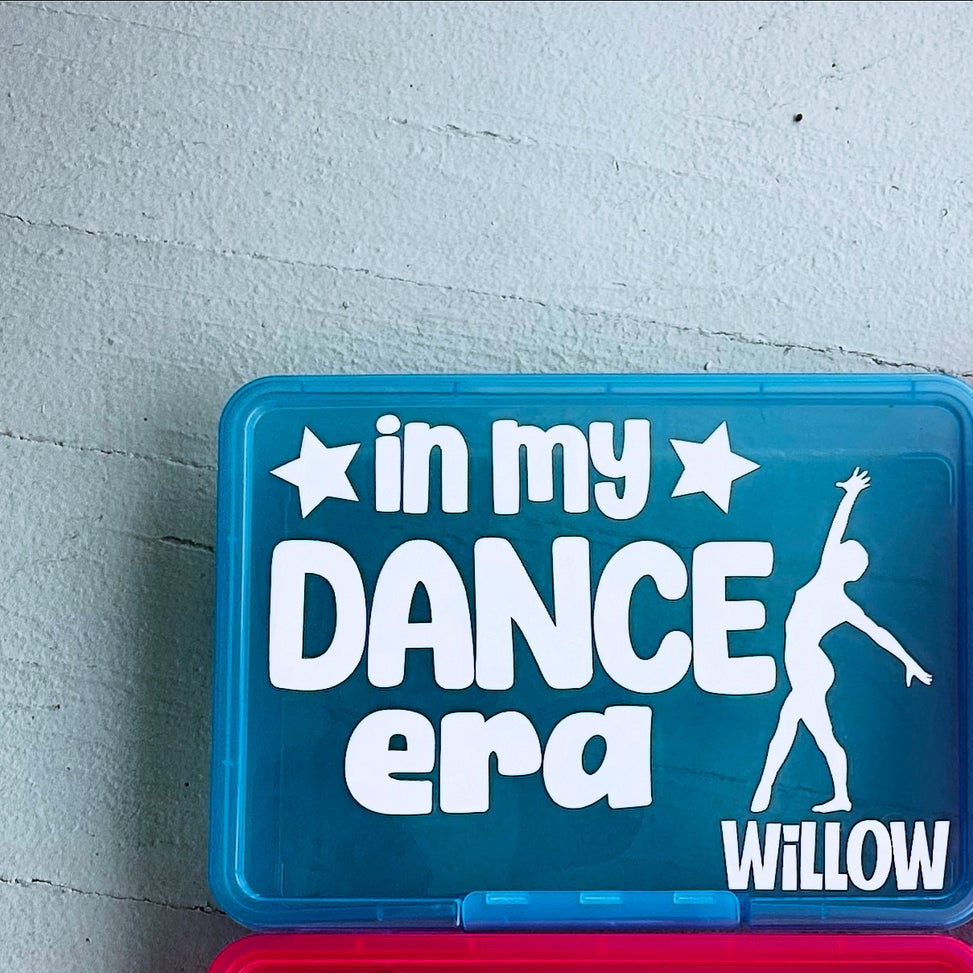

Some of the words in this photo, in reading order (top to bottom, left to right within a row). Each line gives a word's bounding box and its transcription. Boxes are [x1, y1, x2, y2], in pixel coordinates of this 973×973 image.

[376, 415, 468, 513] in
[493, 420, 650, 519] my
[270, 537, 776, 694] DANCE
[345, 706, 651, 814] era
